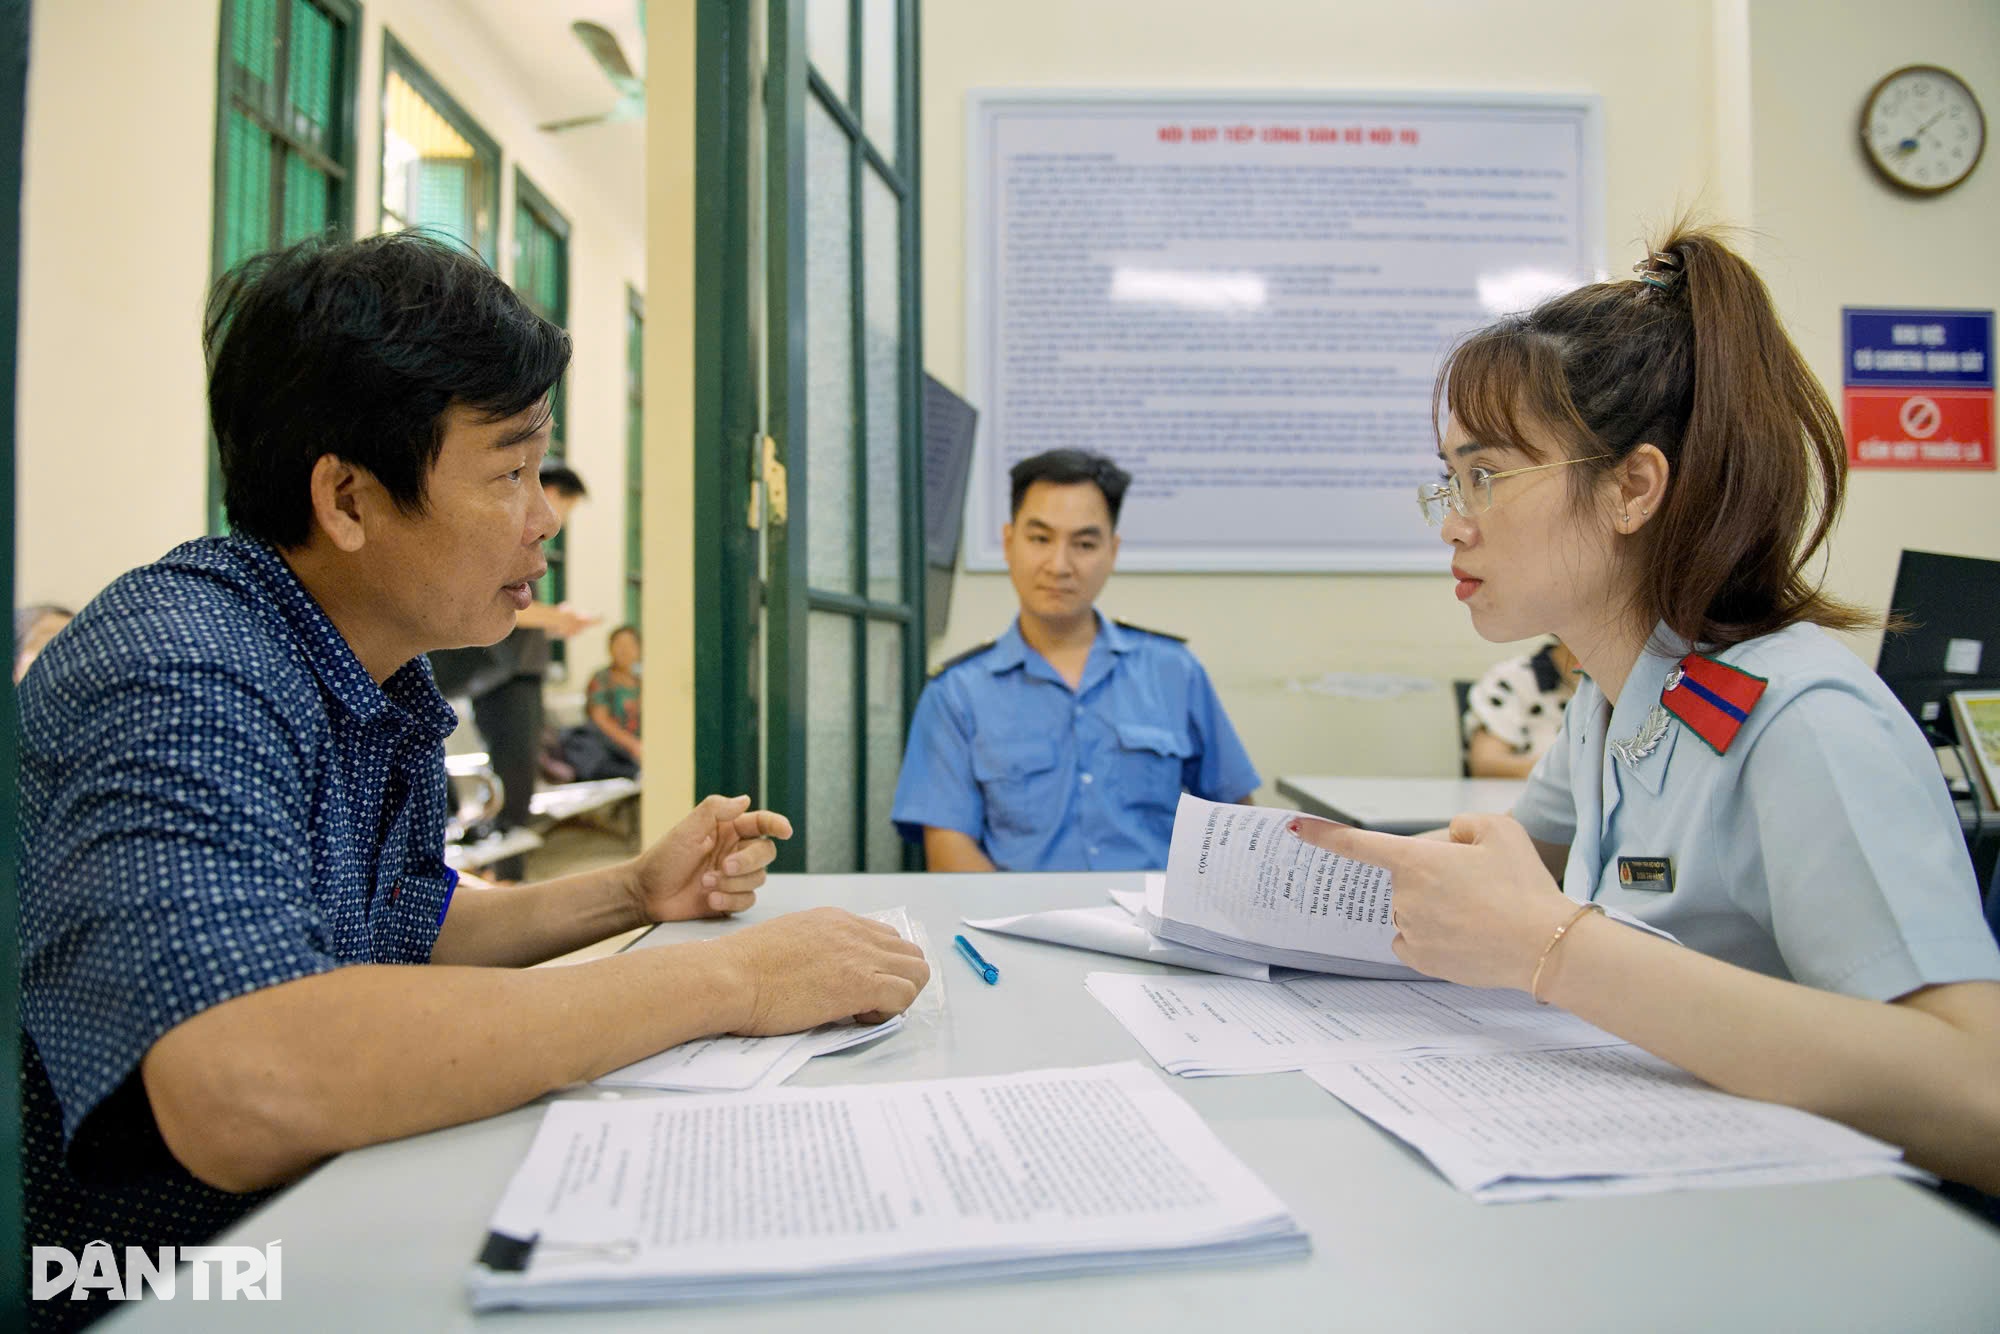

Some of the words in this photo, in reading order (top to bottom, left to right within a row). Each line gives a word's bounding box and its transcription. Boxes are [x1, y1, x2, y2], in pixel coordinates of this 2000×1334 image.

[1198, 851, 1208, 874] CỘNG
[1283, 882, 1291, 899] Kính
[1322, 894, 1329, 902] đã
[1358, 890, 1366, 904] hơn
[1310, 897, 1319, 914] Theo
[1320, 903, 1328, 916] xúc
[1335, 893, 1346, 911] Tổng
[1380, 903, 1389, 924] Chiều
